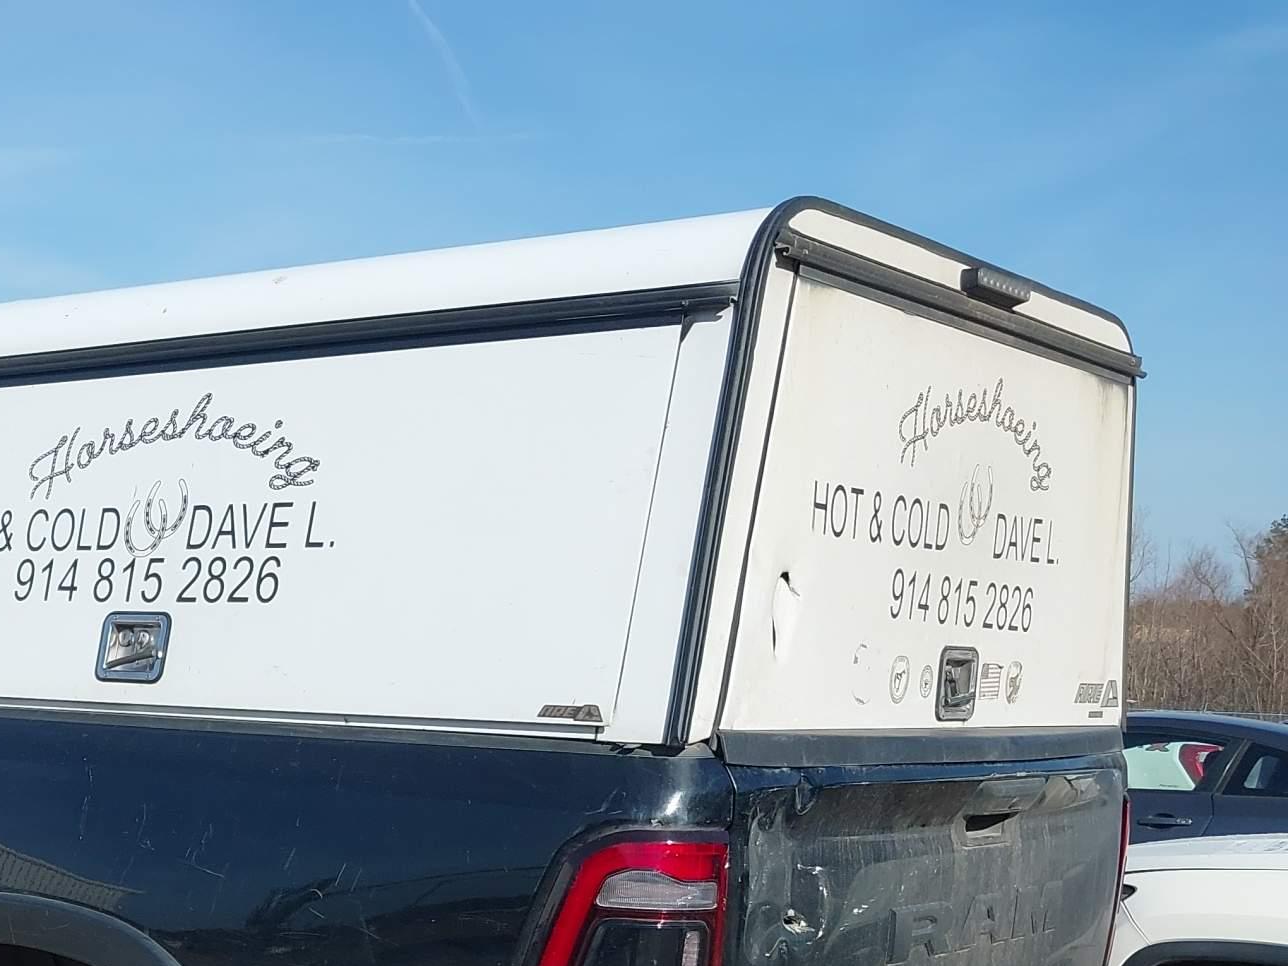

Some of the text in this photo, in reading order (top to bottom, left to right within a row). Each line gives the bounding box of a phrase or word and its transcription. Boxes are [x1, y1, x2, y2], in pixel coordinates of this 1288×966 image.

[29, 392, 320, 500] Horseshoeing
[899, 378, 1051, 491] Horseshoeing
[26, 507, 120, 552] COLD
[186, 502, 293, 550] DAVE
[304, 500, 335, 548] L.
[812, 480, 1059, 564] HOT & COLD DAVE L.
[14, 555, 281, 603] 914 815 2826
[890, 568, 1033, 632] 914 815 2826
